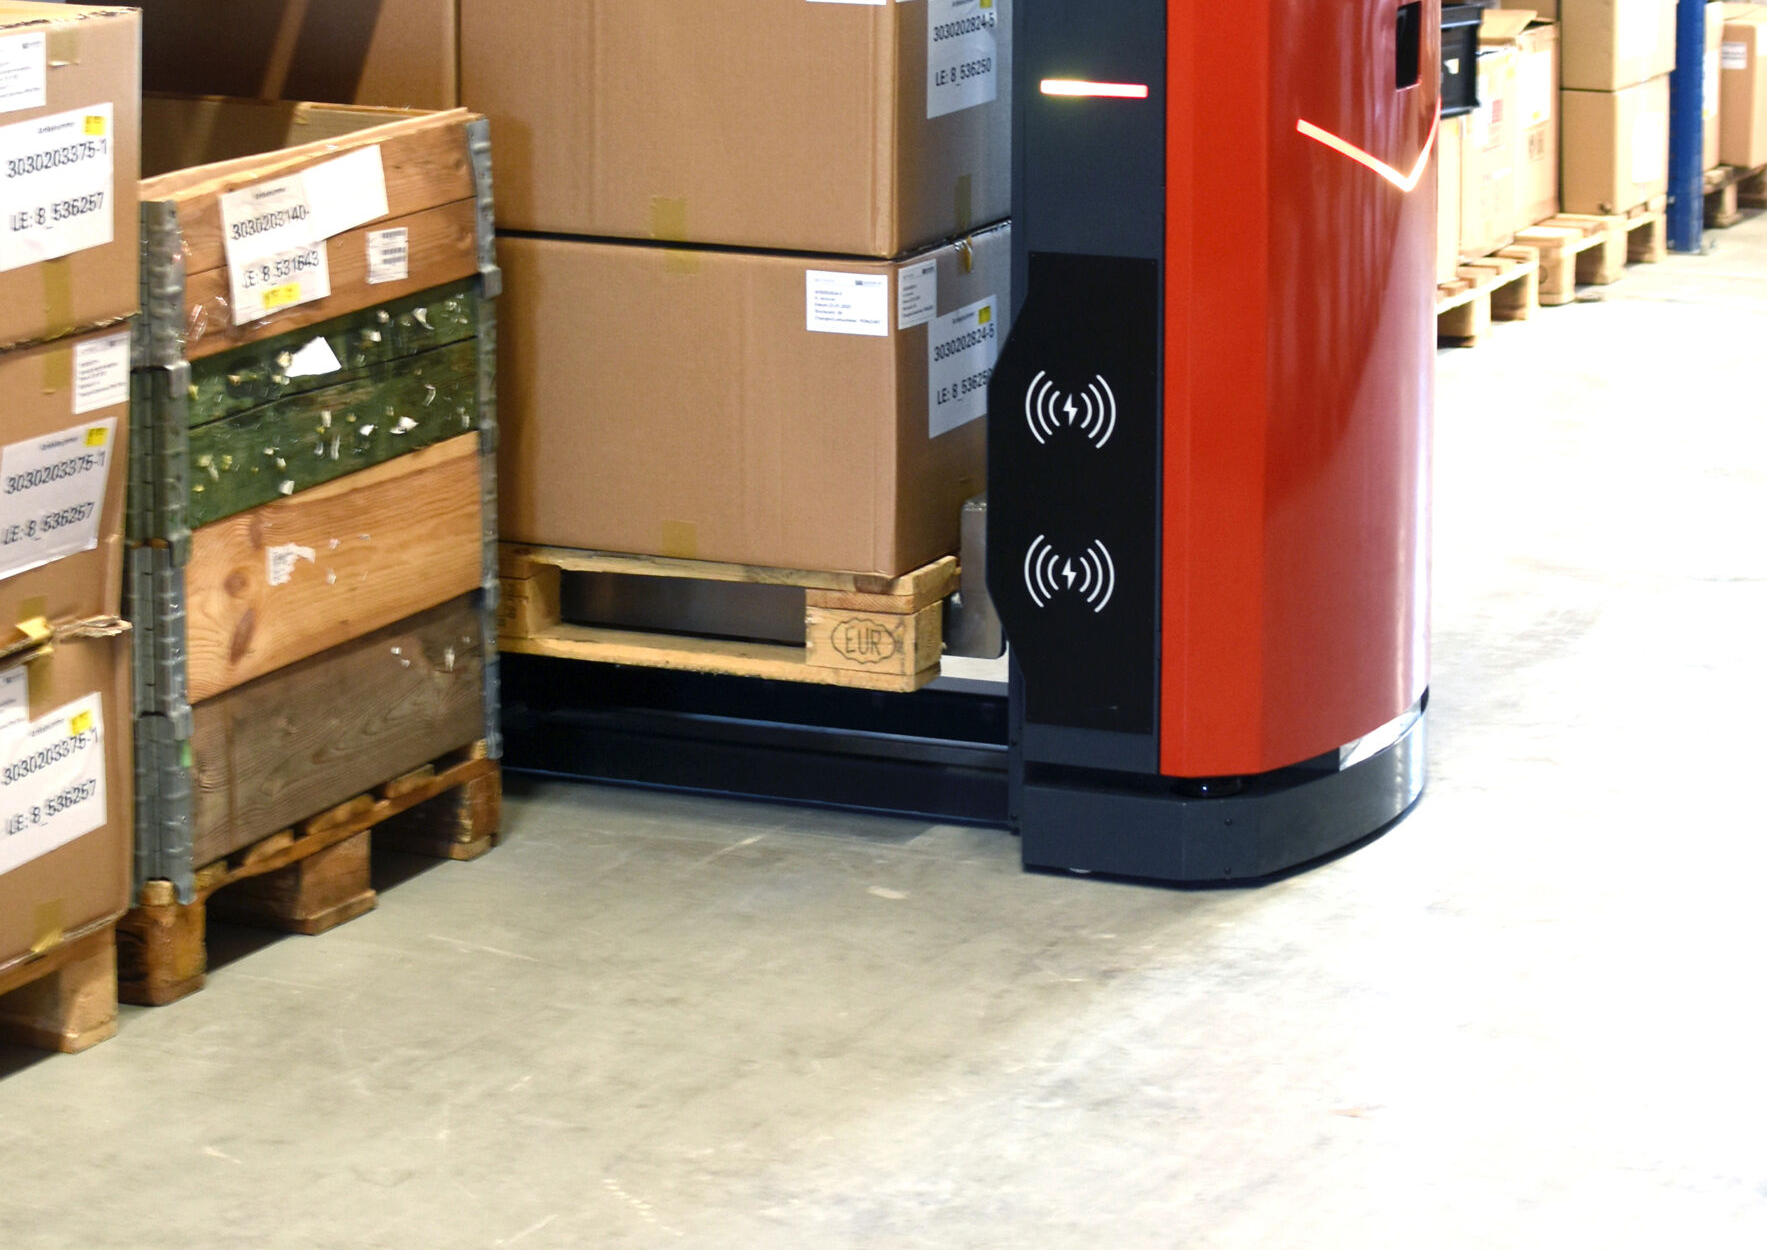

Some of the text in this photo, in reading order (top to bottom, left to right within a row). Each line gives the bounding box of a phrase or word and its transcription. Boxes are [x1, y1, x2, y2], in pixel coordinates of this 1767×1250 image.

[933, 11, 996, 43] 3030202824-5
[6, 138, 108, 179] 3030203375-1
[933, 323, 995, 362] 3030202824-5
[4, 450, 107, 496] 3030203375-1
[844, 625, 882, 656] EUR
[1, 727, 101, 786] 3030203375-1
